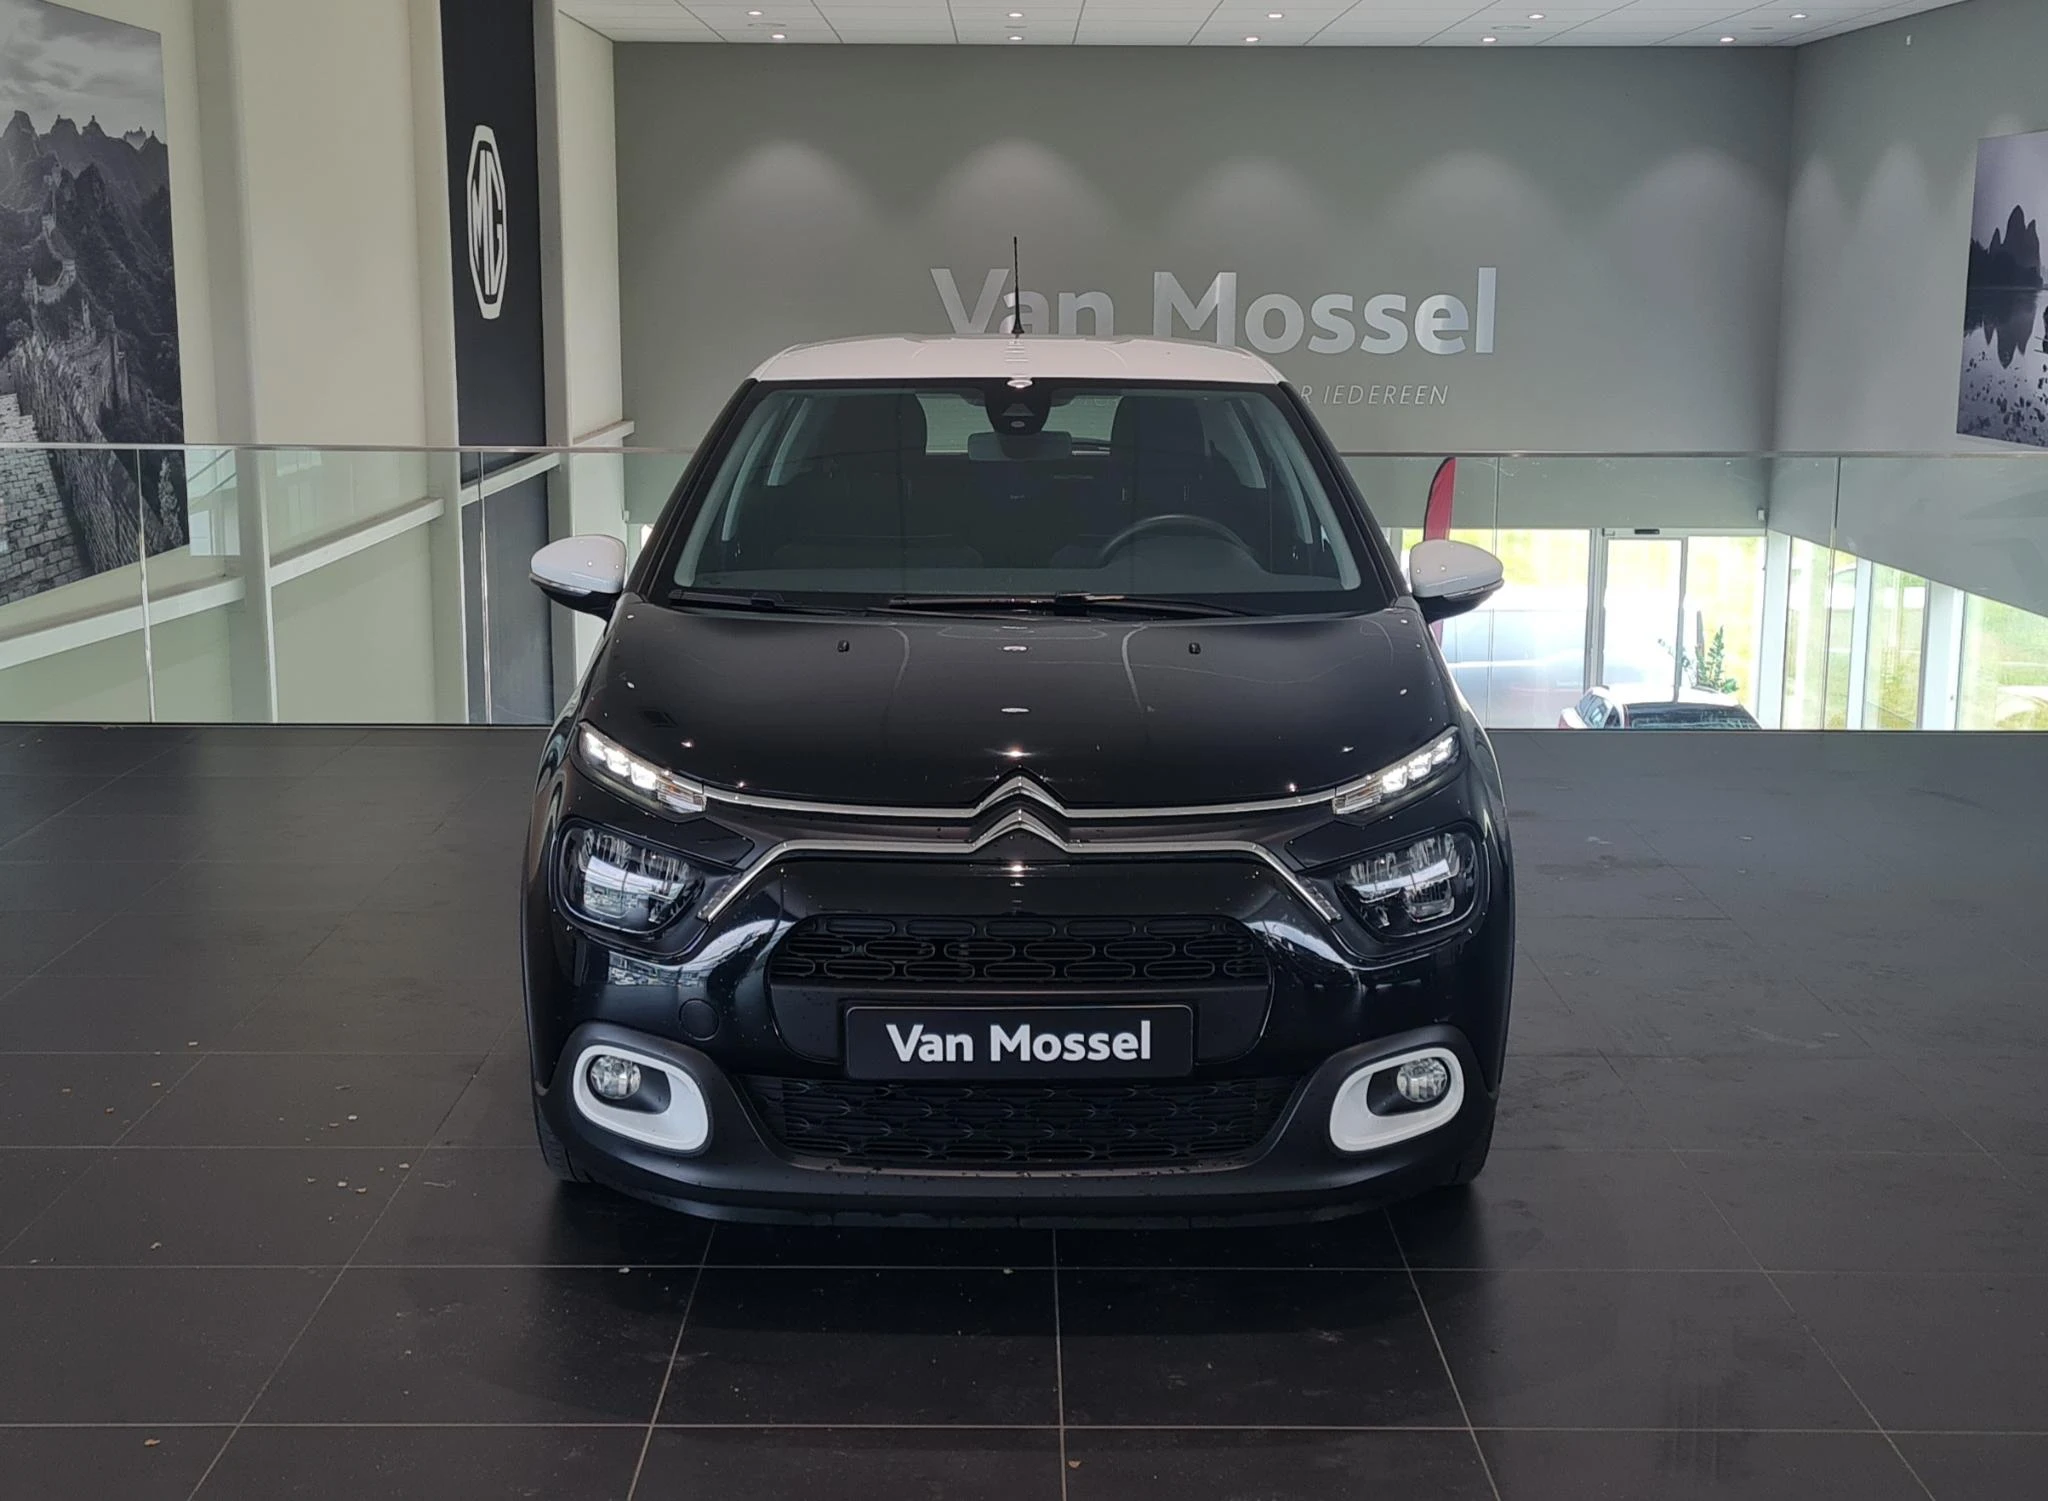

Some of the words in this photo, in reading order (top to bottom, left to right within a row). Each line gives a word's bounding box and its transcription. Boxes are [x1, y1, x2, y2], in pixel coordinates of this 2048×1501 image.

[470, 147, 504, 297] MG
[930, 267, 1115, 337] Van
[1153, 267, 1497, 355] Mossel
[1322, 384, 1450, 405] IEDEREEN
[886, 1023, 973, 1062] Van
[990, 1020, 1151, 1062] Mossel
